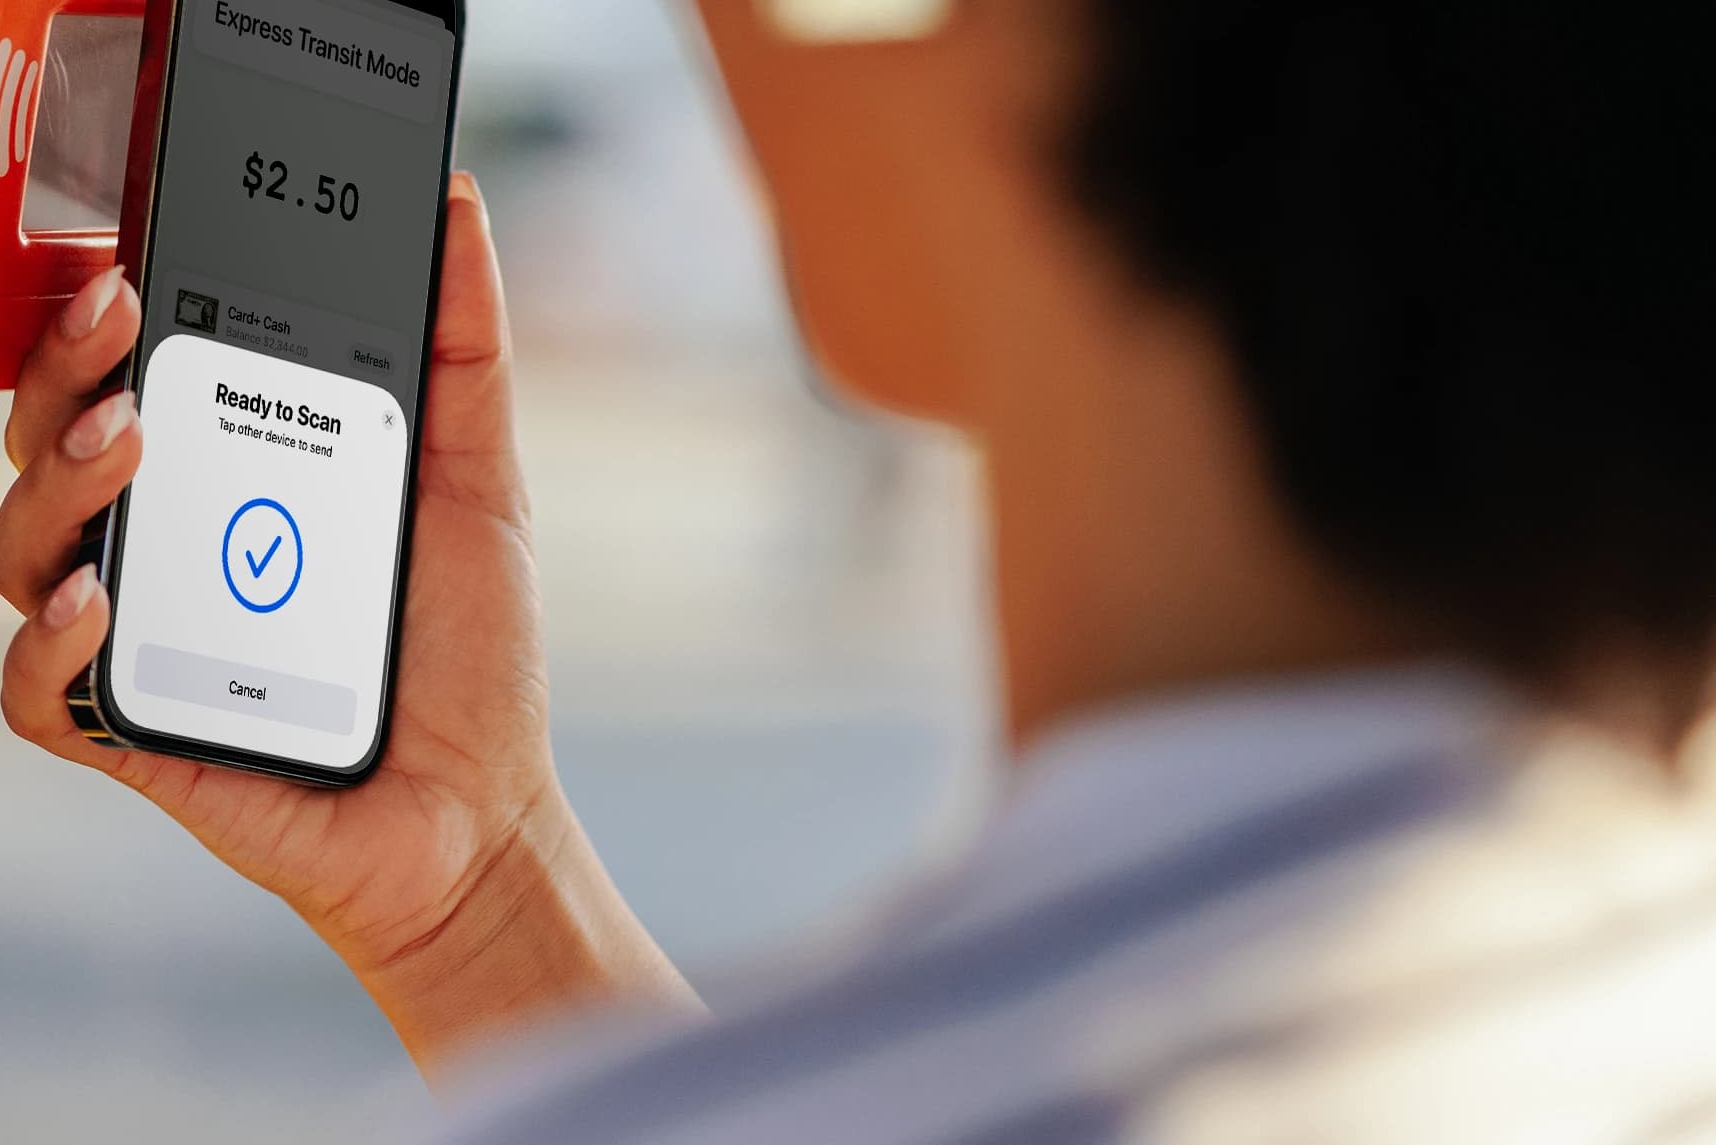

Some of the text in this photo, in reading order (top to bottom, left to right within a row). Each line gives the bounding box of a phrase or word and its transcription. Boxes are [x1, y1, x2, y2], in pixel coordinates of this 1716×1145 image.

[215, 0, 420, 87] Express Transit Mode
[243, 151, 359, 221] $2.50
[226, 326, 261, 345] Balance
[228, 306, 291, 335] Card+ Cash
[353, 350, 390, 370] Refresh
[215, 383, 341, 435] Ready to Scan
[219, 417, 332, 458] Tap other device to send
[229, 680, 267, 701] Cancel
